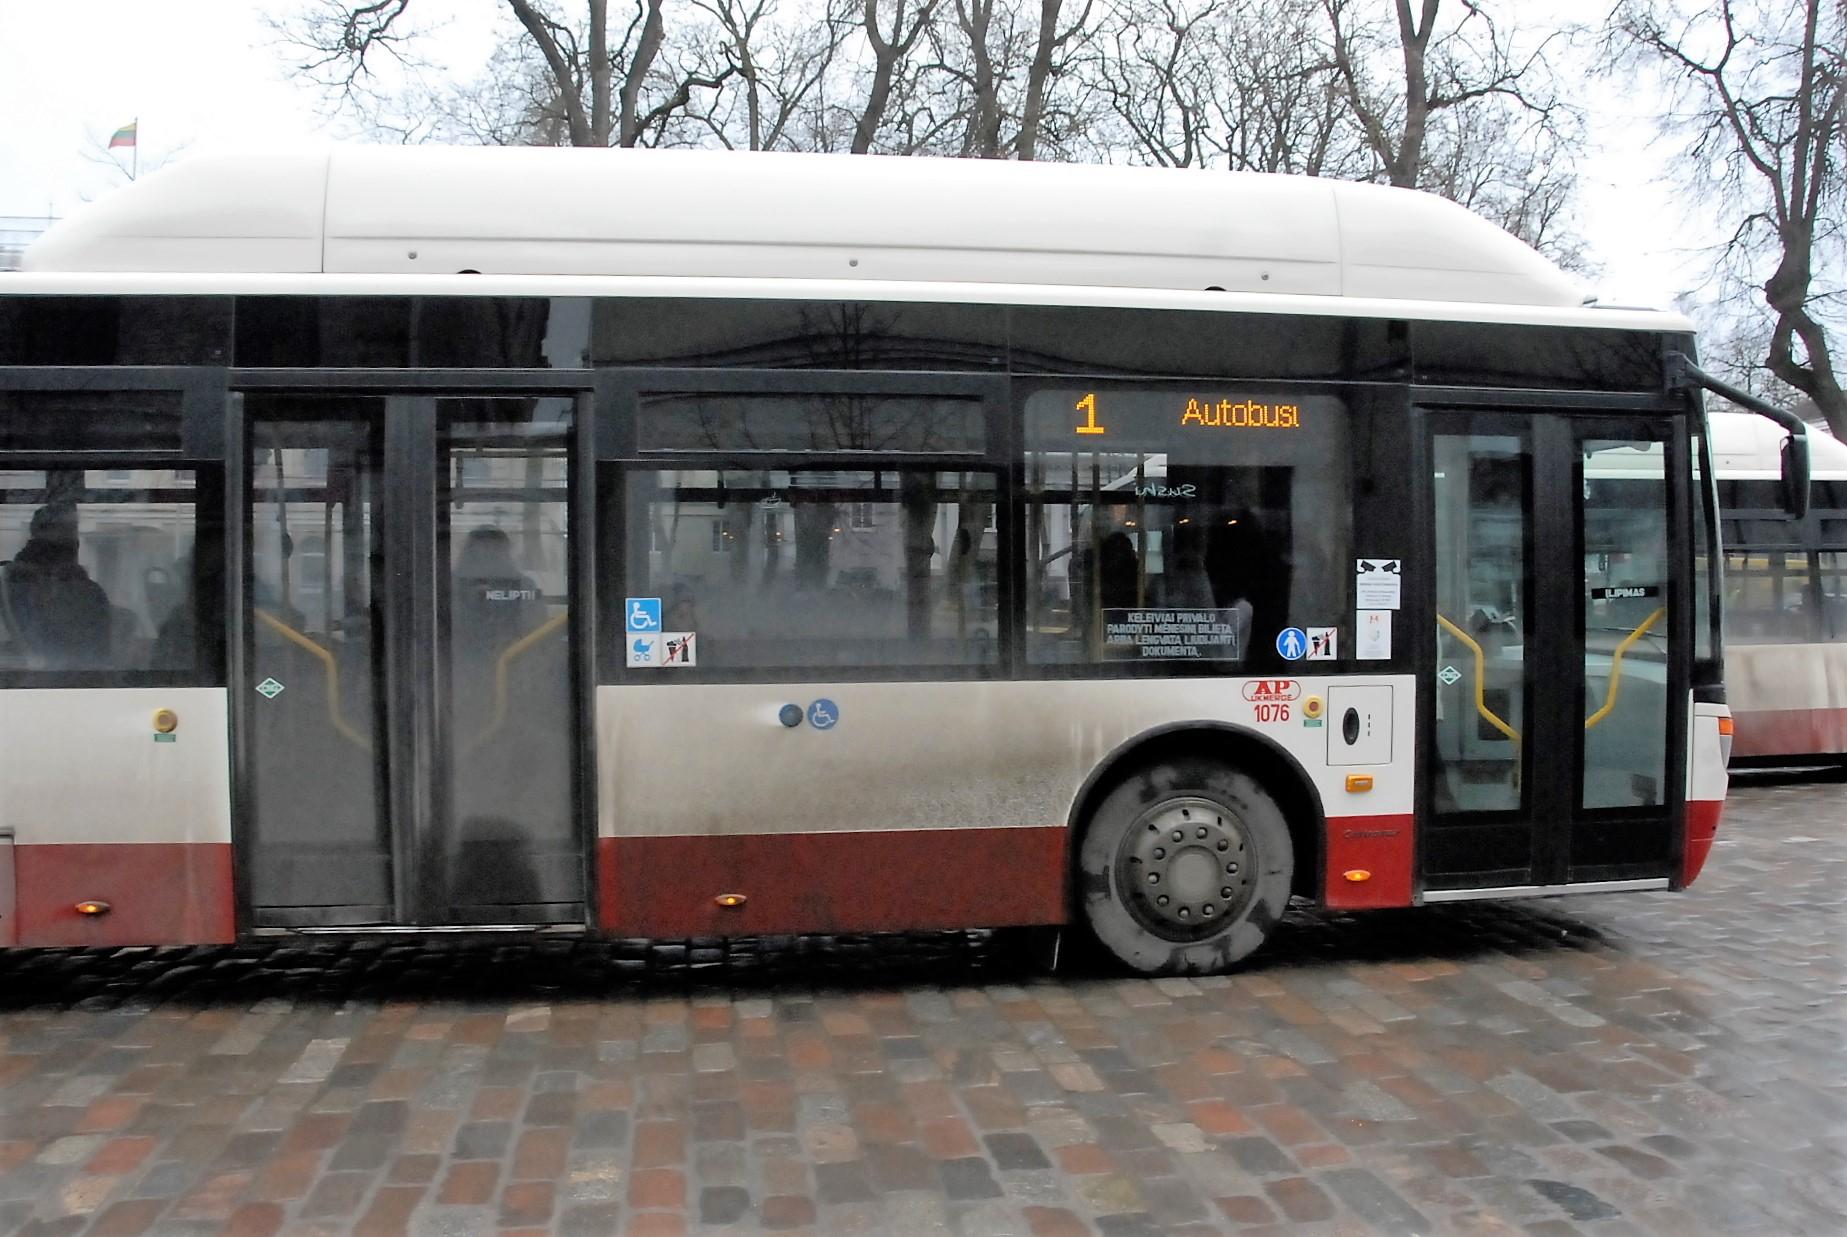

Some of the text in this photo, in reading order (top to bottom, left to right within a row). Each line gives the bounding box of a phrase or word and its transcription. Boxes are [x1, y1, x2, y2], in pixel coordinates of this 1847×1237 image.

[1076, 394, 1104, 434] 1
[1128, 613, 1215, 623] KELEIVIAI PRIVALO
[1107, 624, 1152, 634] PARODYTI
[1254, 680, 1290, 694] AP
[1254, 704, 1290, 722] 1076
